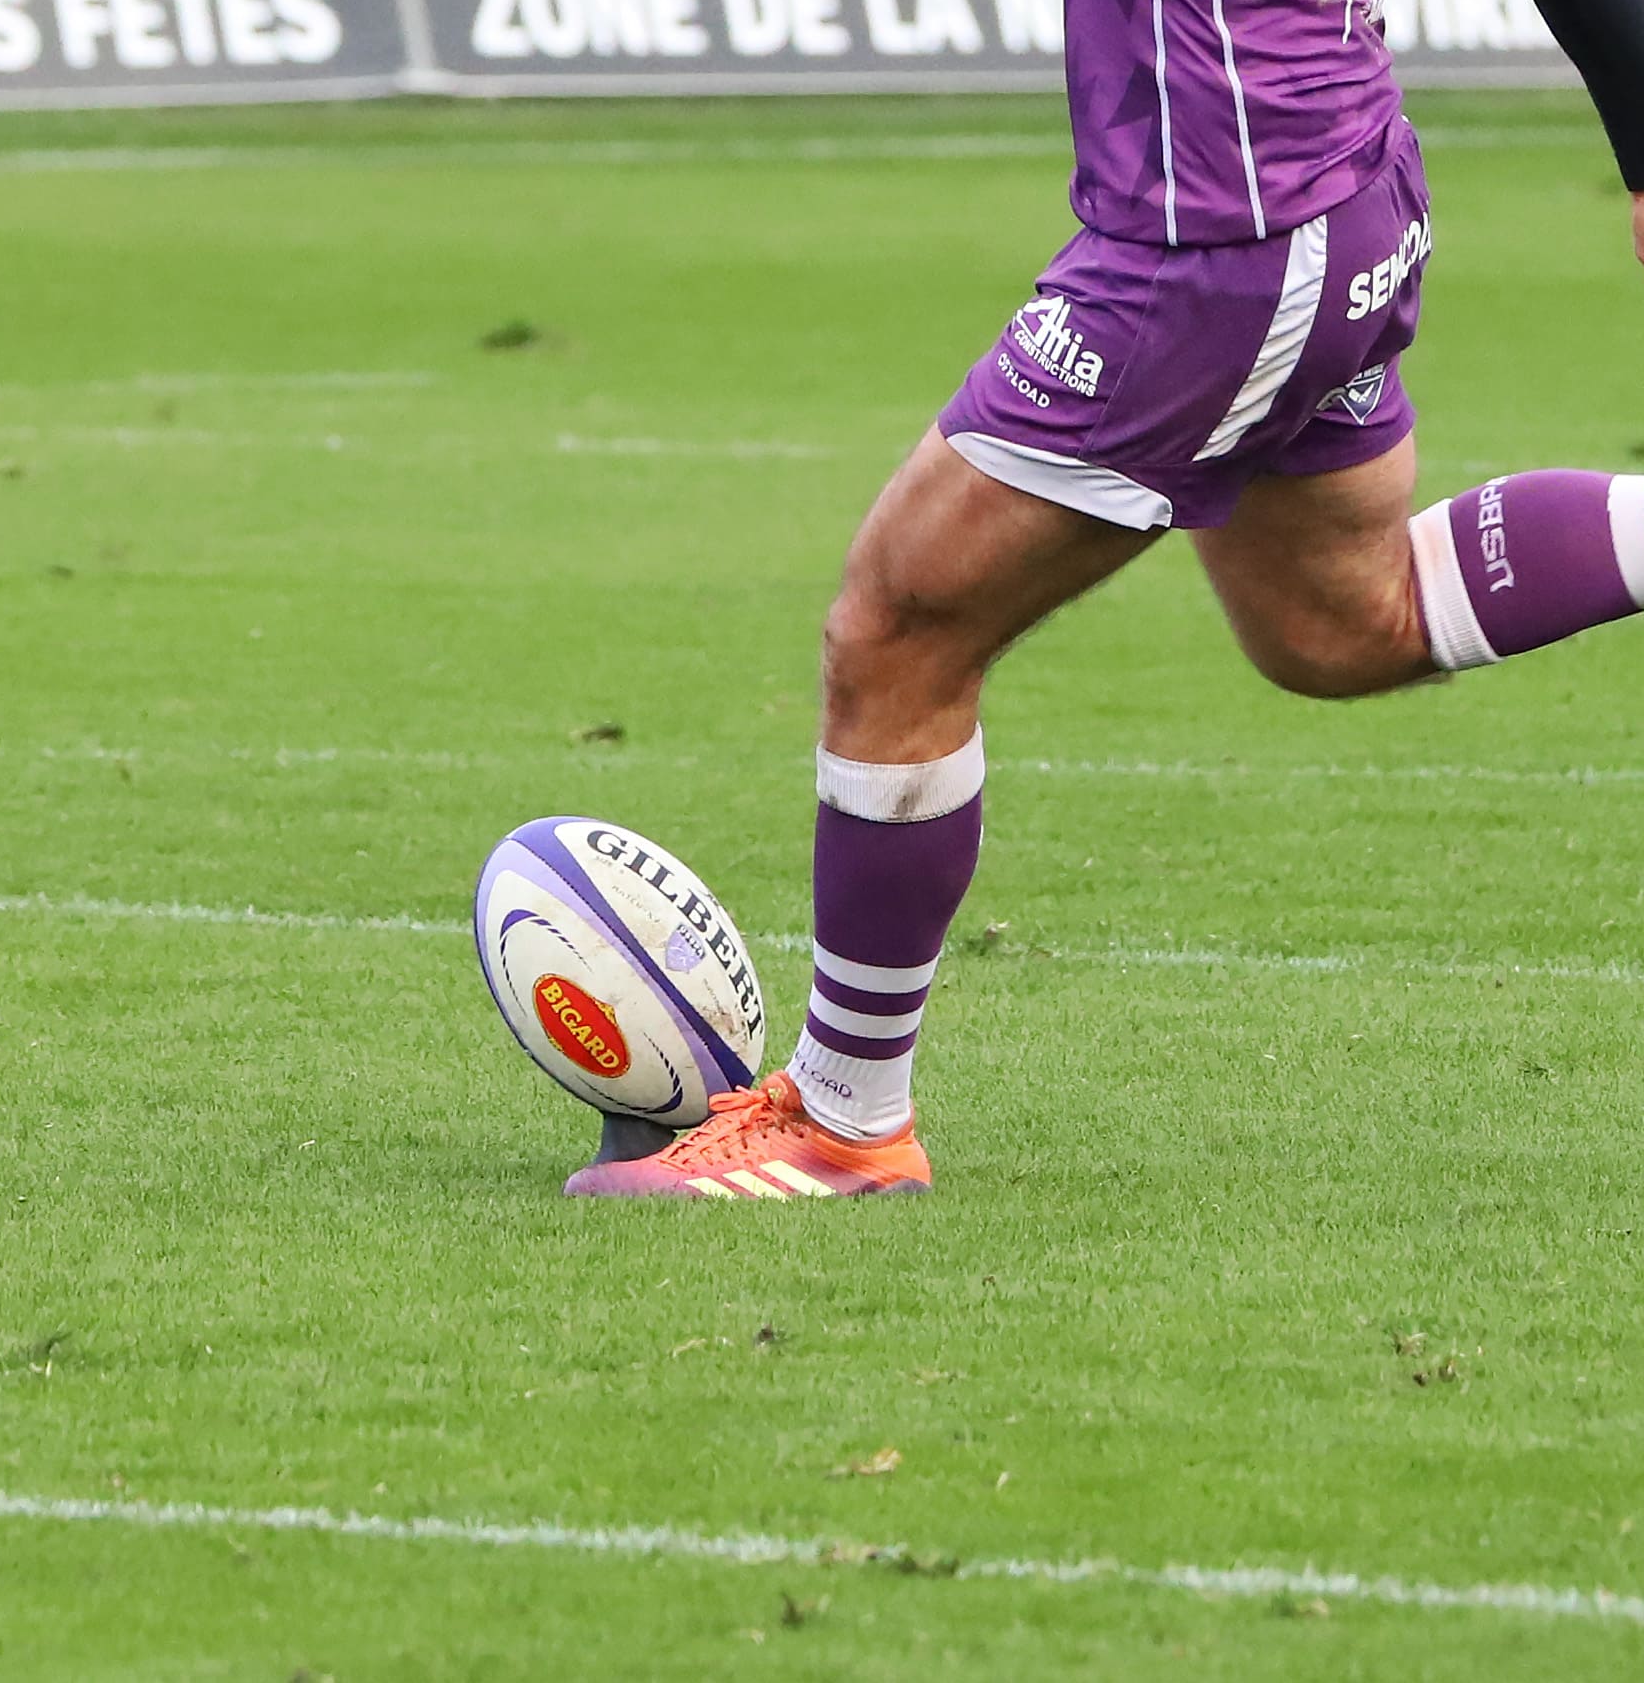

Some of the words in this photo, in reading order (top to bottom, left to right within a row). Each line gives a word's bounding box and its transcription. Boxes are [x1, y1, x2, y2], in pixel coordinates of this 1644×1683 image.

[1014, 329, 1097, 398] CONSTRUCTIONS
[1476, 474, 1516, 593] USBP
[586, 829, 765, 1042] GILBERT
[540, 981, 621, 1070] BIGARD
